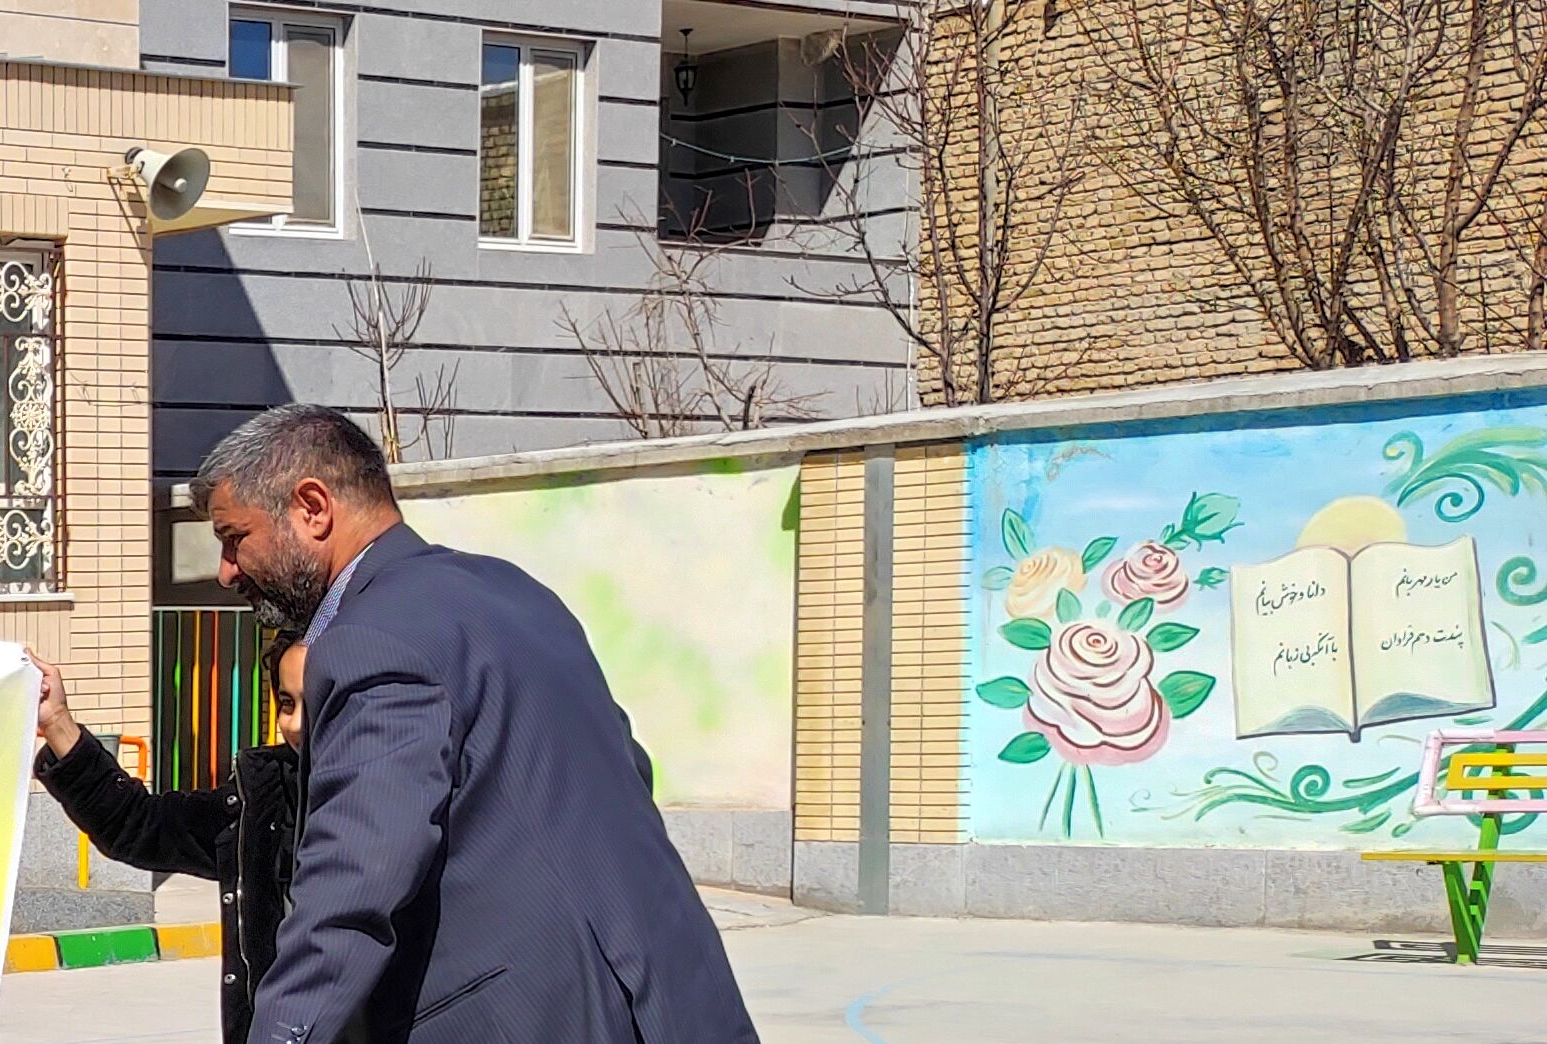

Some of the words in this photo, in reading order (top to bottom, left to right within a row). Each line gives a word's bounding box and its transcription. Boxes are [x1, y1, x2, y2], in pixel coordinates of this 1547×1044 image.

[1395, 567, 1428, 599] مهربانم
[1424, 573, 1441, 589] یار
[1441, 571, 1458, 585] من
[1306, 580, 1326, 600] دانا
[1380, 624, 1415, 651] فراوان
